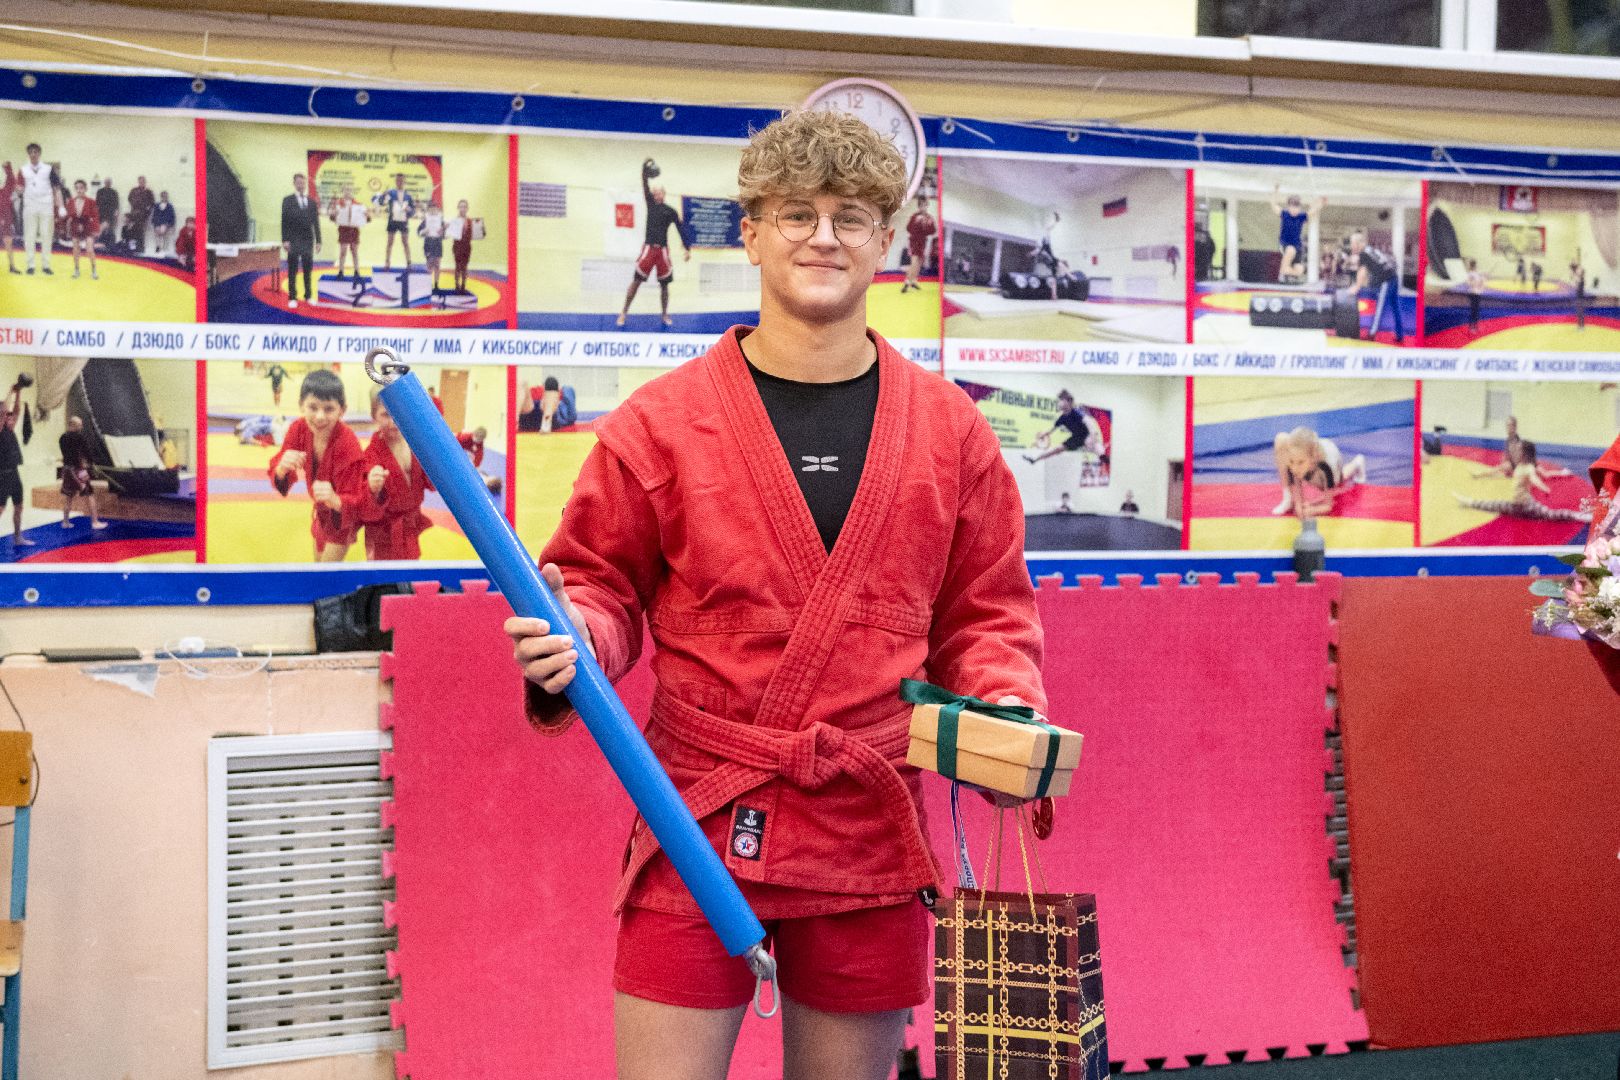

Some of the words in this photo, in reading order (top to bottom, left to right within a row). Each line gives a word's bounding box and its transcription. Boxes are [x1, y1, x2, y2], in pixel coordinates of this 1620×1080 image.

[847, 92, 864, 109] 12
[57, 330, 105, 347] САМБО
[132, 330, 183, 349] ДЗЮДО
[206, 333, 240, 350] БОКС
[262, 332, 317, 353] АЙКИДО
[434, 339, 462, 354] ММА
[483, 339, 563, 355] КИКБОКСИНГ
[584, 341, 640, 357] ФИТБОКС
[659, 343, 713, 358] ЖЕНСКА
[959, 347, 1065, 364] WWW.SKSAMBIST.RU
[1082, 351, 1119, 365] САМБО
[1138, 352, 1178, 367] ДЗЮДО
[1193, 353, 1219, 367] БОКС
[1235, 350, 1276, 369] АЙКИДО
